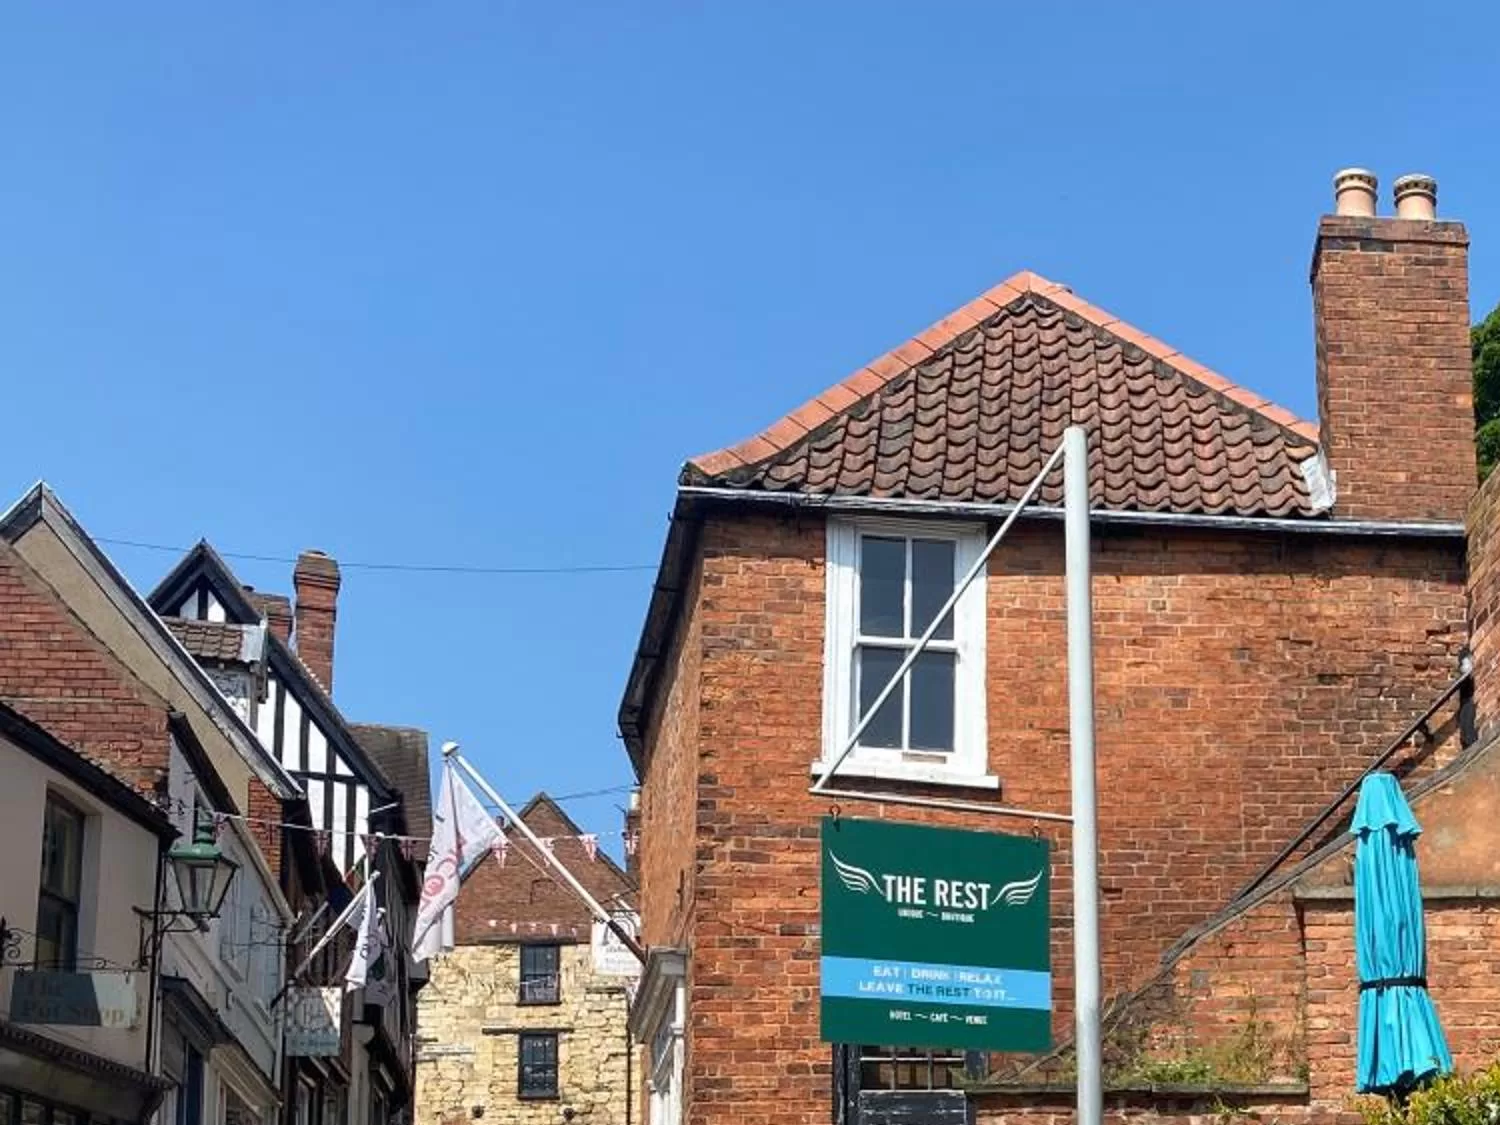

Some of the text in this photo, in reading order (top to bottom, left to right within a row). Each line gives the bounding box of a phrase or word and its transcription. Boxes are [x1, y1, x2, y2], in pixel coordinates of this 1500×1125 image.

[882, 874, 991, 910] THE REST
[872, 965, 1003, 985] EAT DRINK RELAX
[859, 981, 904, 993] LEAVE
[908, 983, 933, 995] THE
[936, 985, 970, 998] REST
